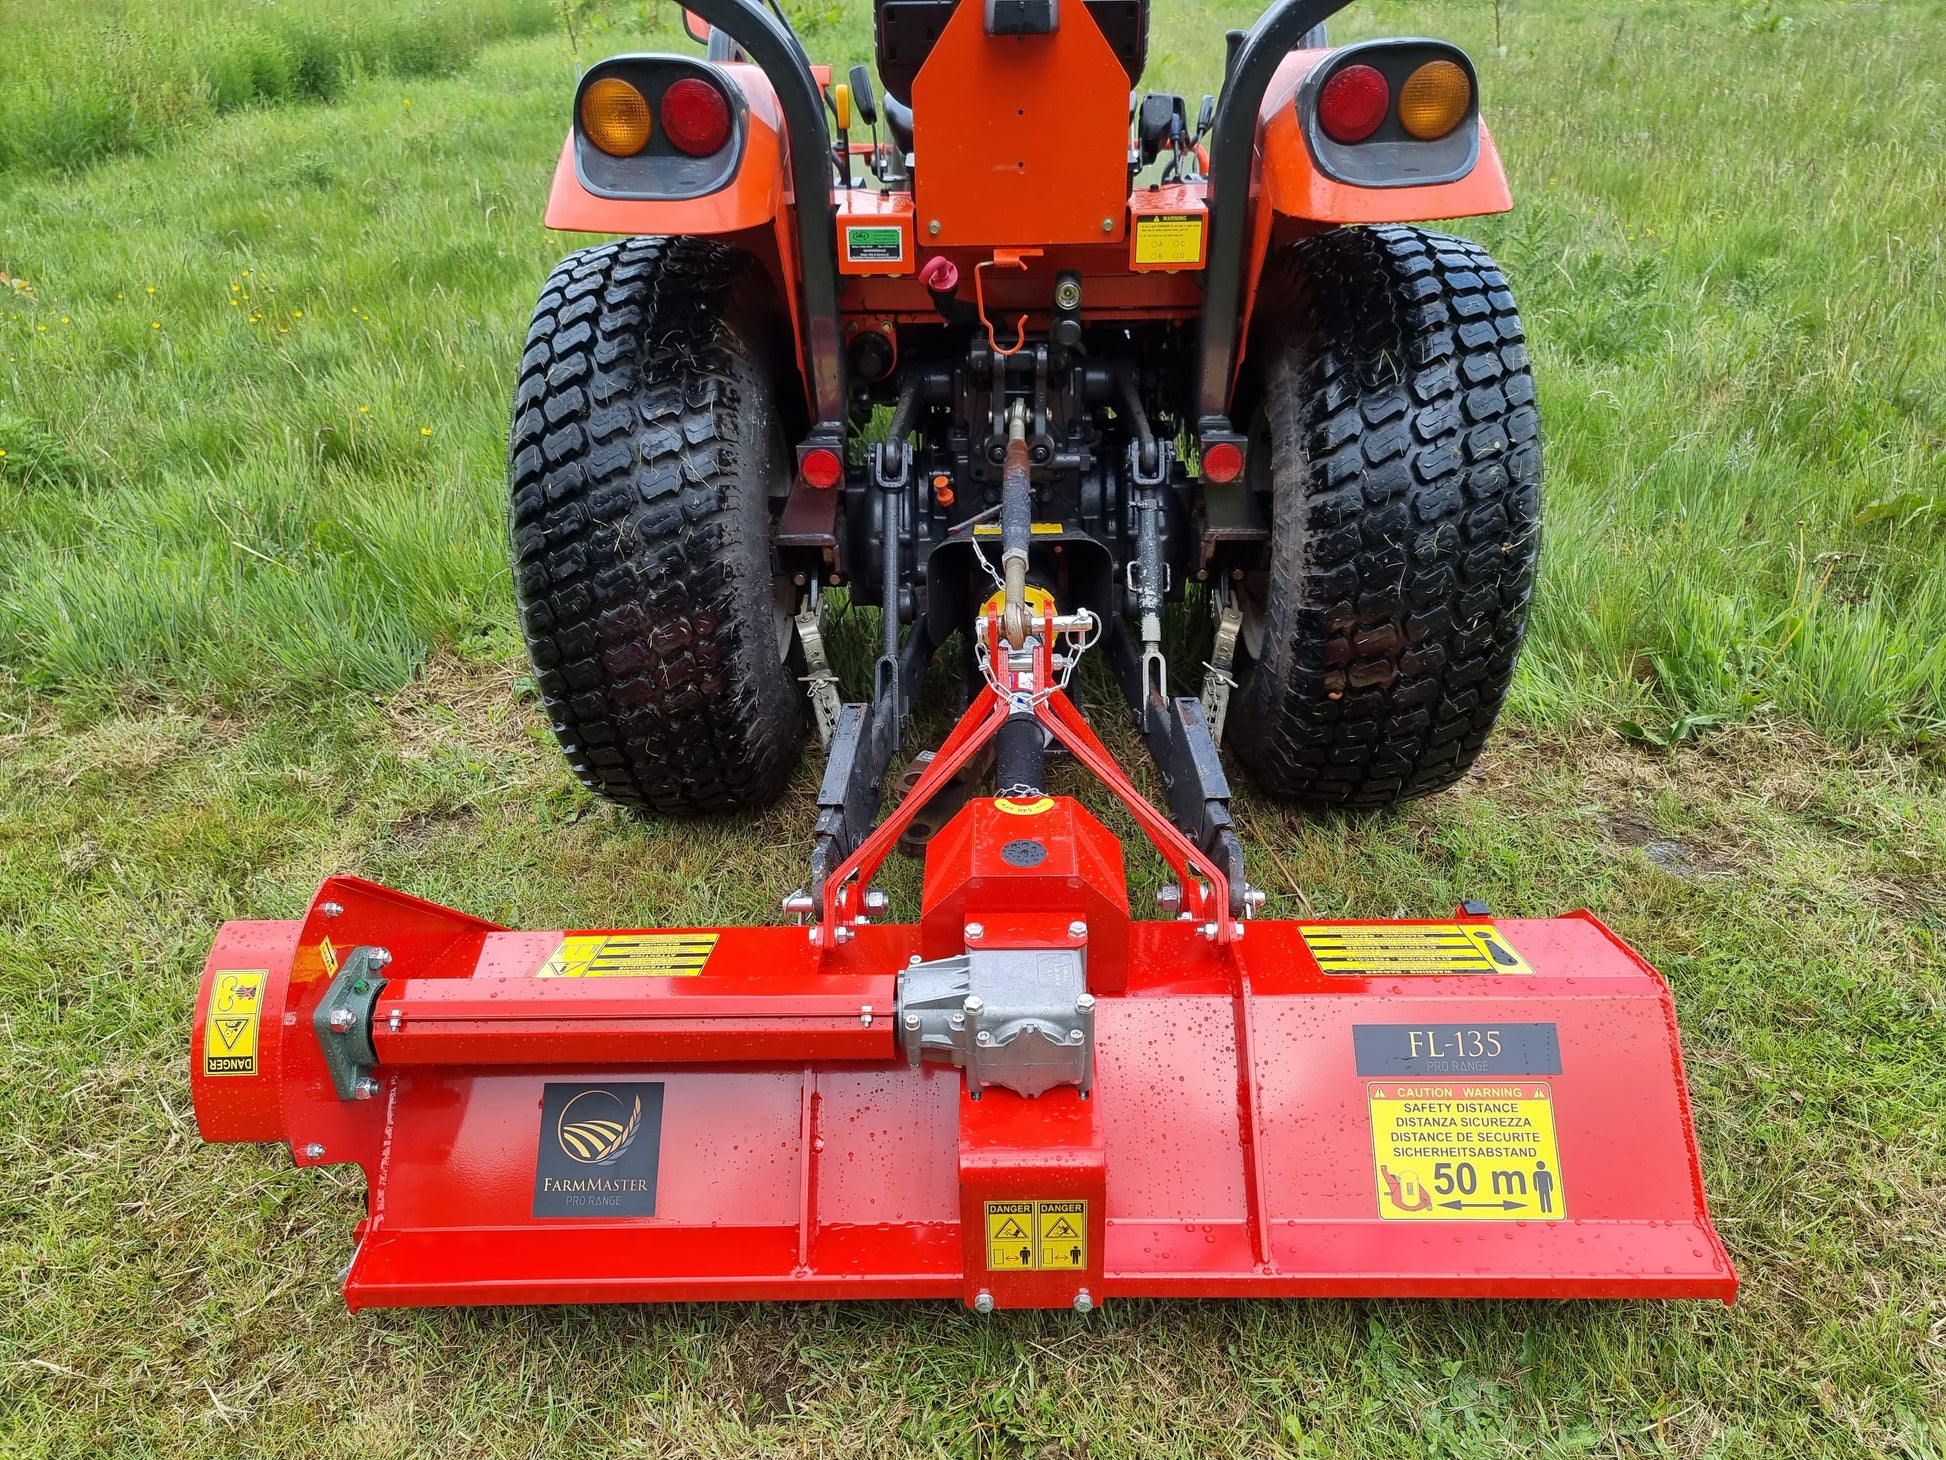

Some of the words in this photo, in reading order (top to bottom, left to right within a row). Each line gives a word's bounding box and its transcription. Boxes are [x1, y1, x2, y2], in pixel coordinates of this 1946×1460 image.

[1408, 1030, 1502, 1057] FL-135
[209, 1058, 252, 1070] DANGER
[1427, 1061, 1449, 1071] PRO
[1452, 1061, 1489, 1071] RANGE
[1397, 1087, 1453, 1098] CAUTION
[1463, 1087, 1523, 1098] WARNING
[1404, 1103, 1451, 1113] SAFETY
[1456, 1103, 1519, 1113] DISTANCE
[1396, 1117, 1458, 1127] DISTANZA
[1460, 1117, 1532, 1127] SICUREZZA
[1391, 1132, 1452, 1142] DISTANCE
[1457, 1132, 1474, 1142] DE
[1477, 1132, 1541, 1142] SECURITE
[1393, 1147, 1537, 1157] SICHERHEITSABSTAND
[1433, 1163, 1477, 1195] 50
[1491, 1169, 1528, 1195] m
[566, 1195, 586, 1206] PRO
[588, 1195, 621, 1206] RANGE
[990, 1205, 1031, 1213] DANGER
[1041, 1204, 1082, 1212] DANGER
